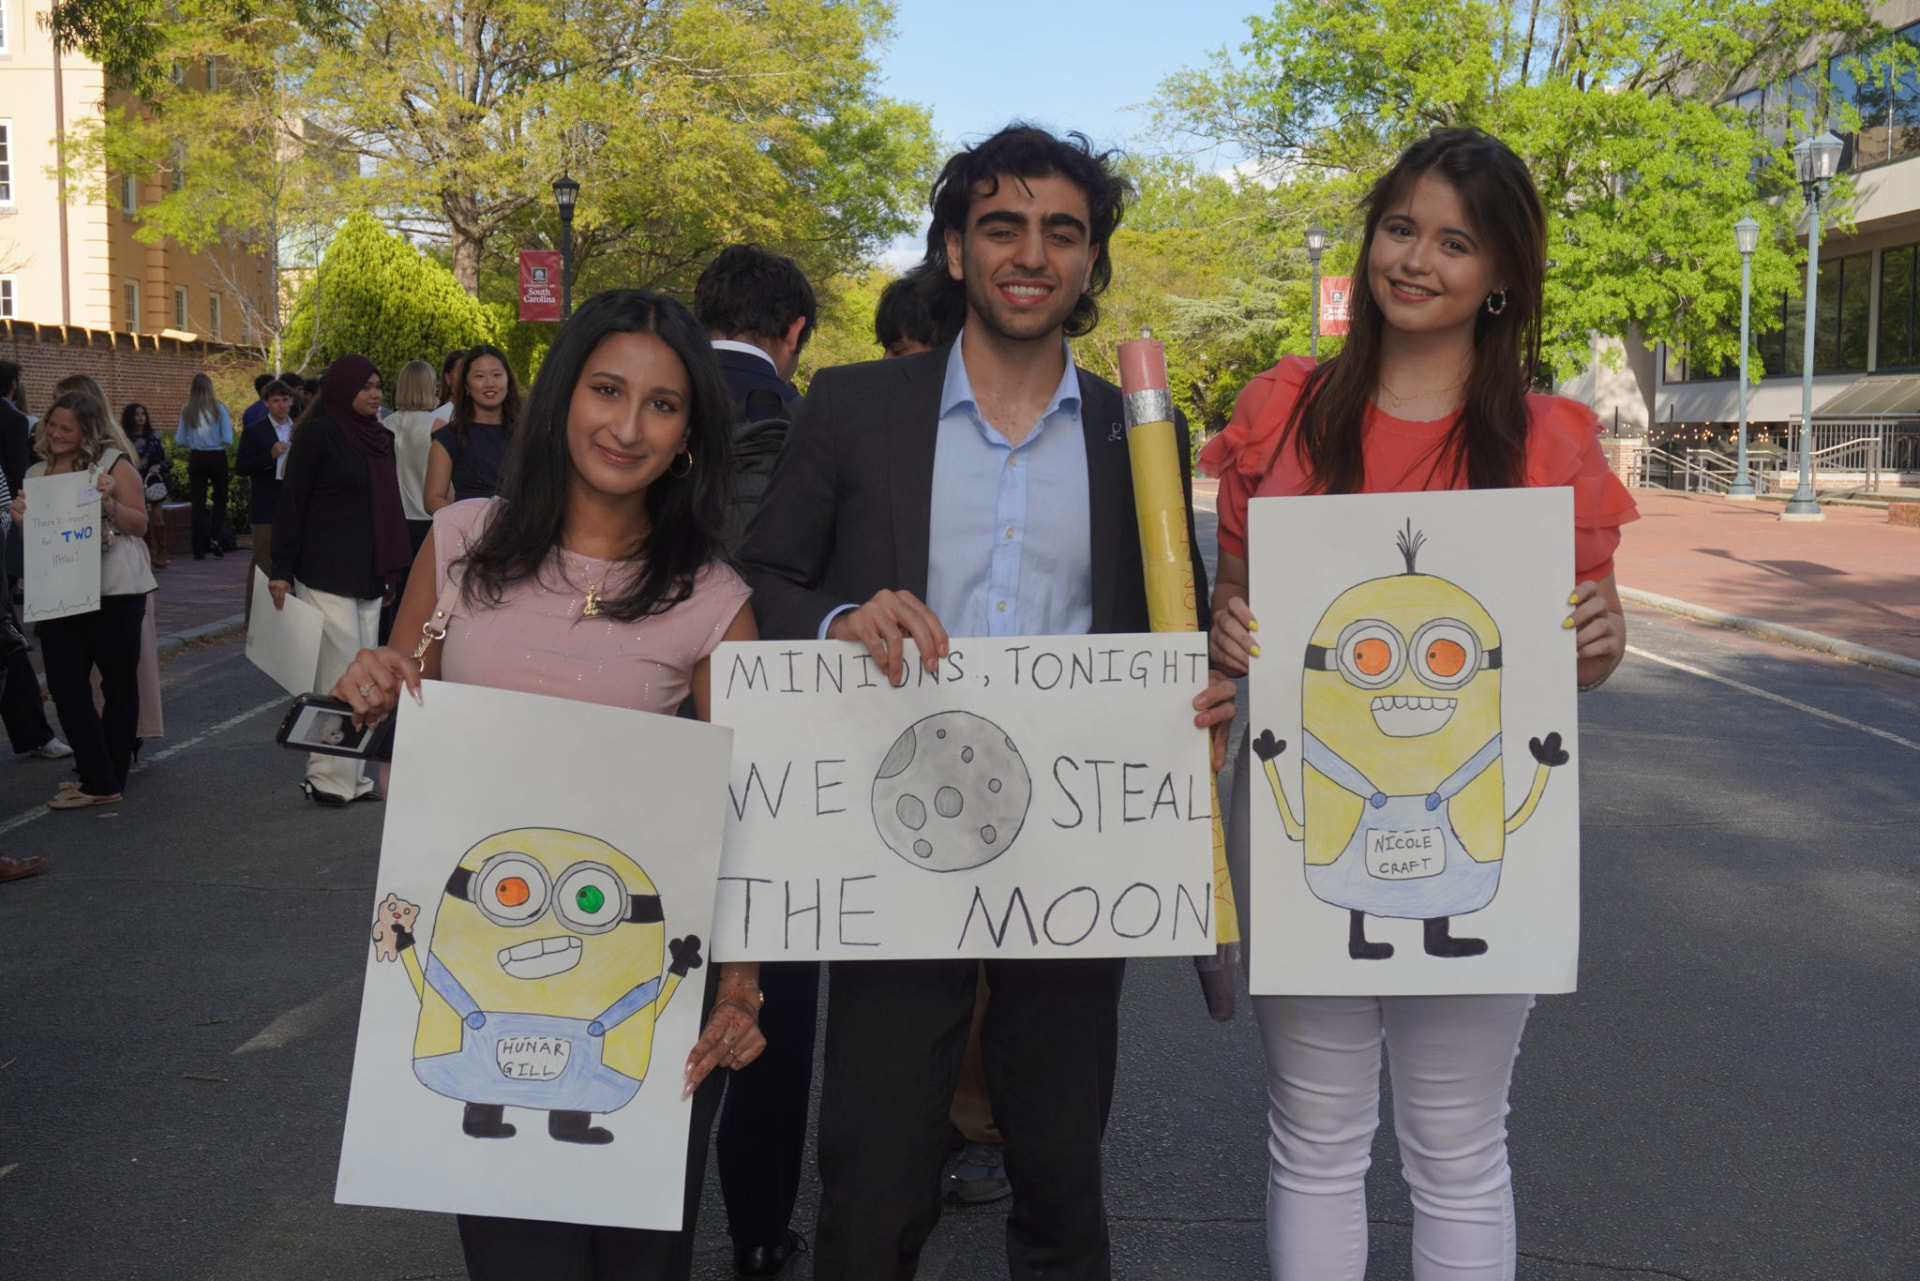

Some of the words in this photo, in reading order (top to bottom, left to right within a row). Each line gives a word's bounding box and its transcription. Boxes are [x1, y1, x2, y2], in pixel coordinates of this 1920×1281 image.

[523, 295, 555, 303] Carolina
[61, 525, 93, 543] TWO
[1005, 646, 1208, 690] TONIGHT
[728, 760, 847, 821] WE
[1052, 756, 1212, 833] STEAL
[1375, 835, 1432, 853] NICOLE
[1379, 858, 1432, 874] CRAFT
[718, 875, 881, 950] THE
[958, 882, 1211, 950] MOON
[503, 1041, 564, 1056] HUNAR
[503, 1061, 555, 1076] GILL
